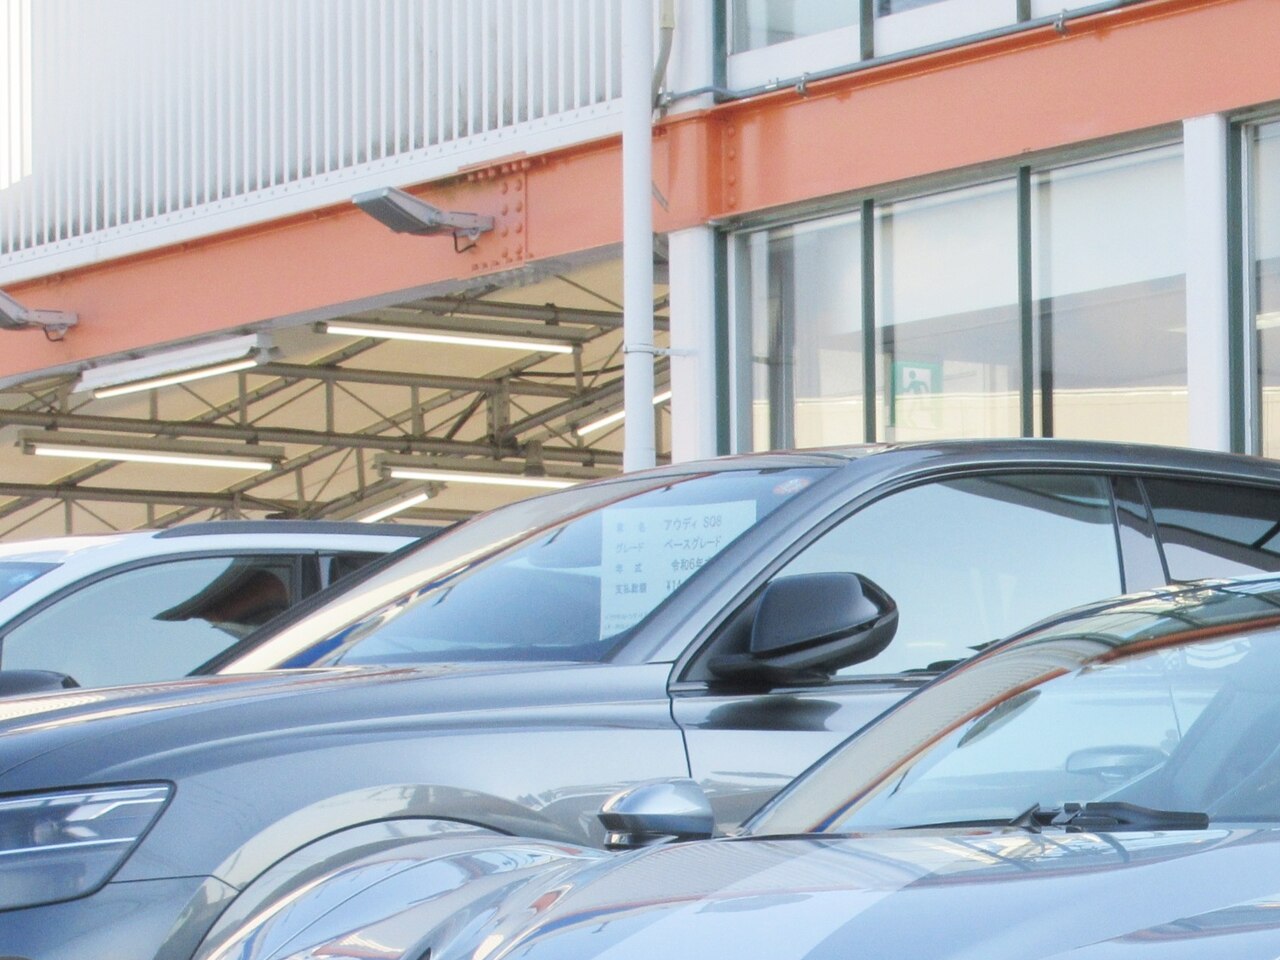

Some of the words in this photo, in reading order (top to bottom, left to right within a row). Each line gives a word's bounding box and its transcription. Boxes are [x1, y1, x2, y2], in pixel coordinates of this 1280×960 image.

[664, 517, 697, 531] アウディ
[703, 515, 722, 528] SQ8
